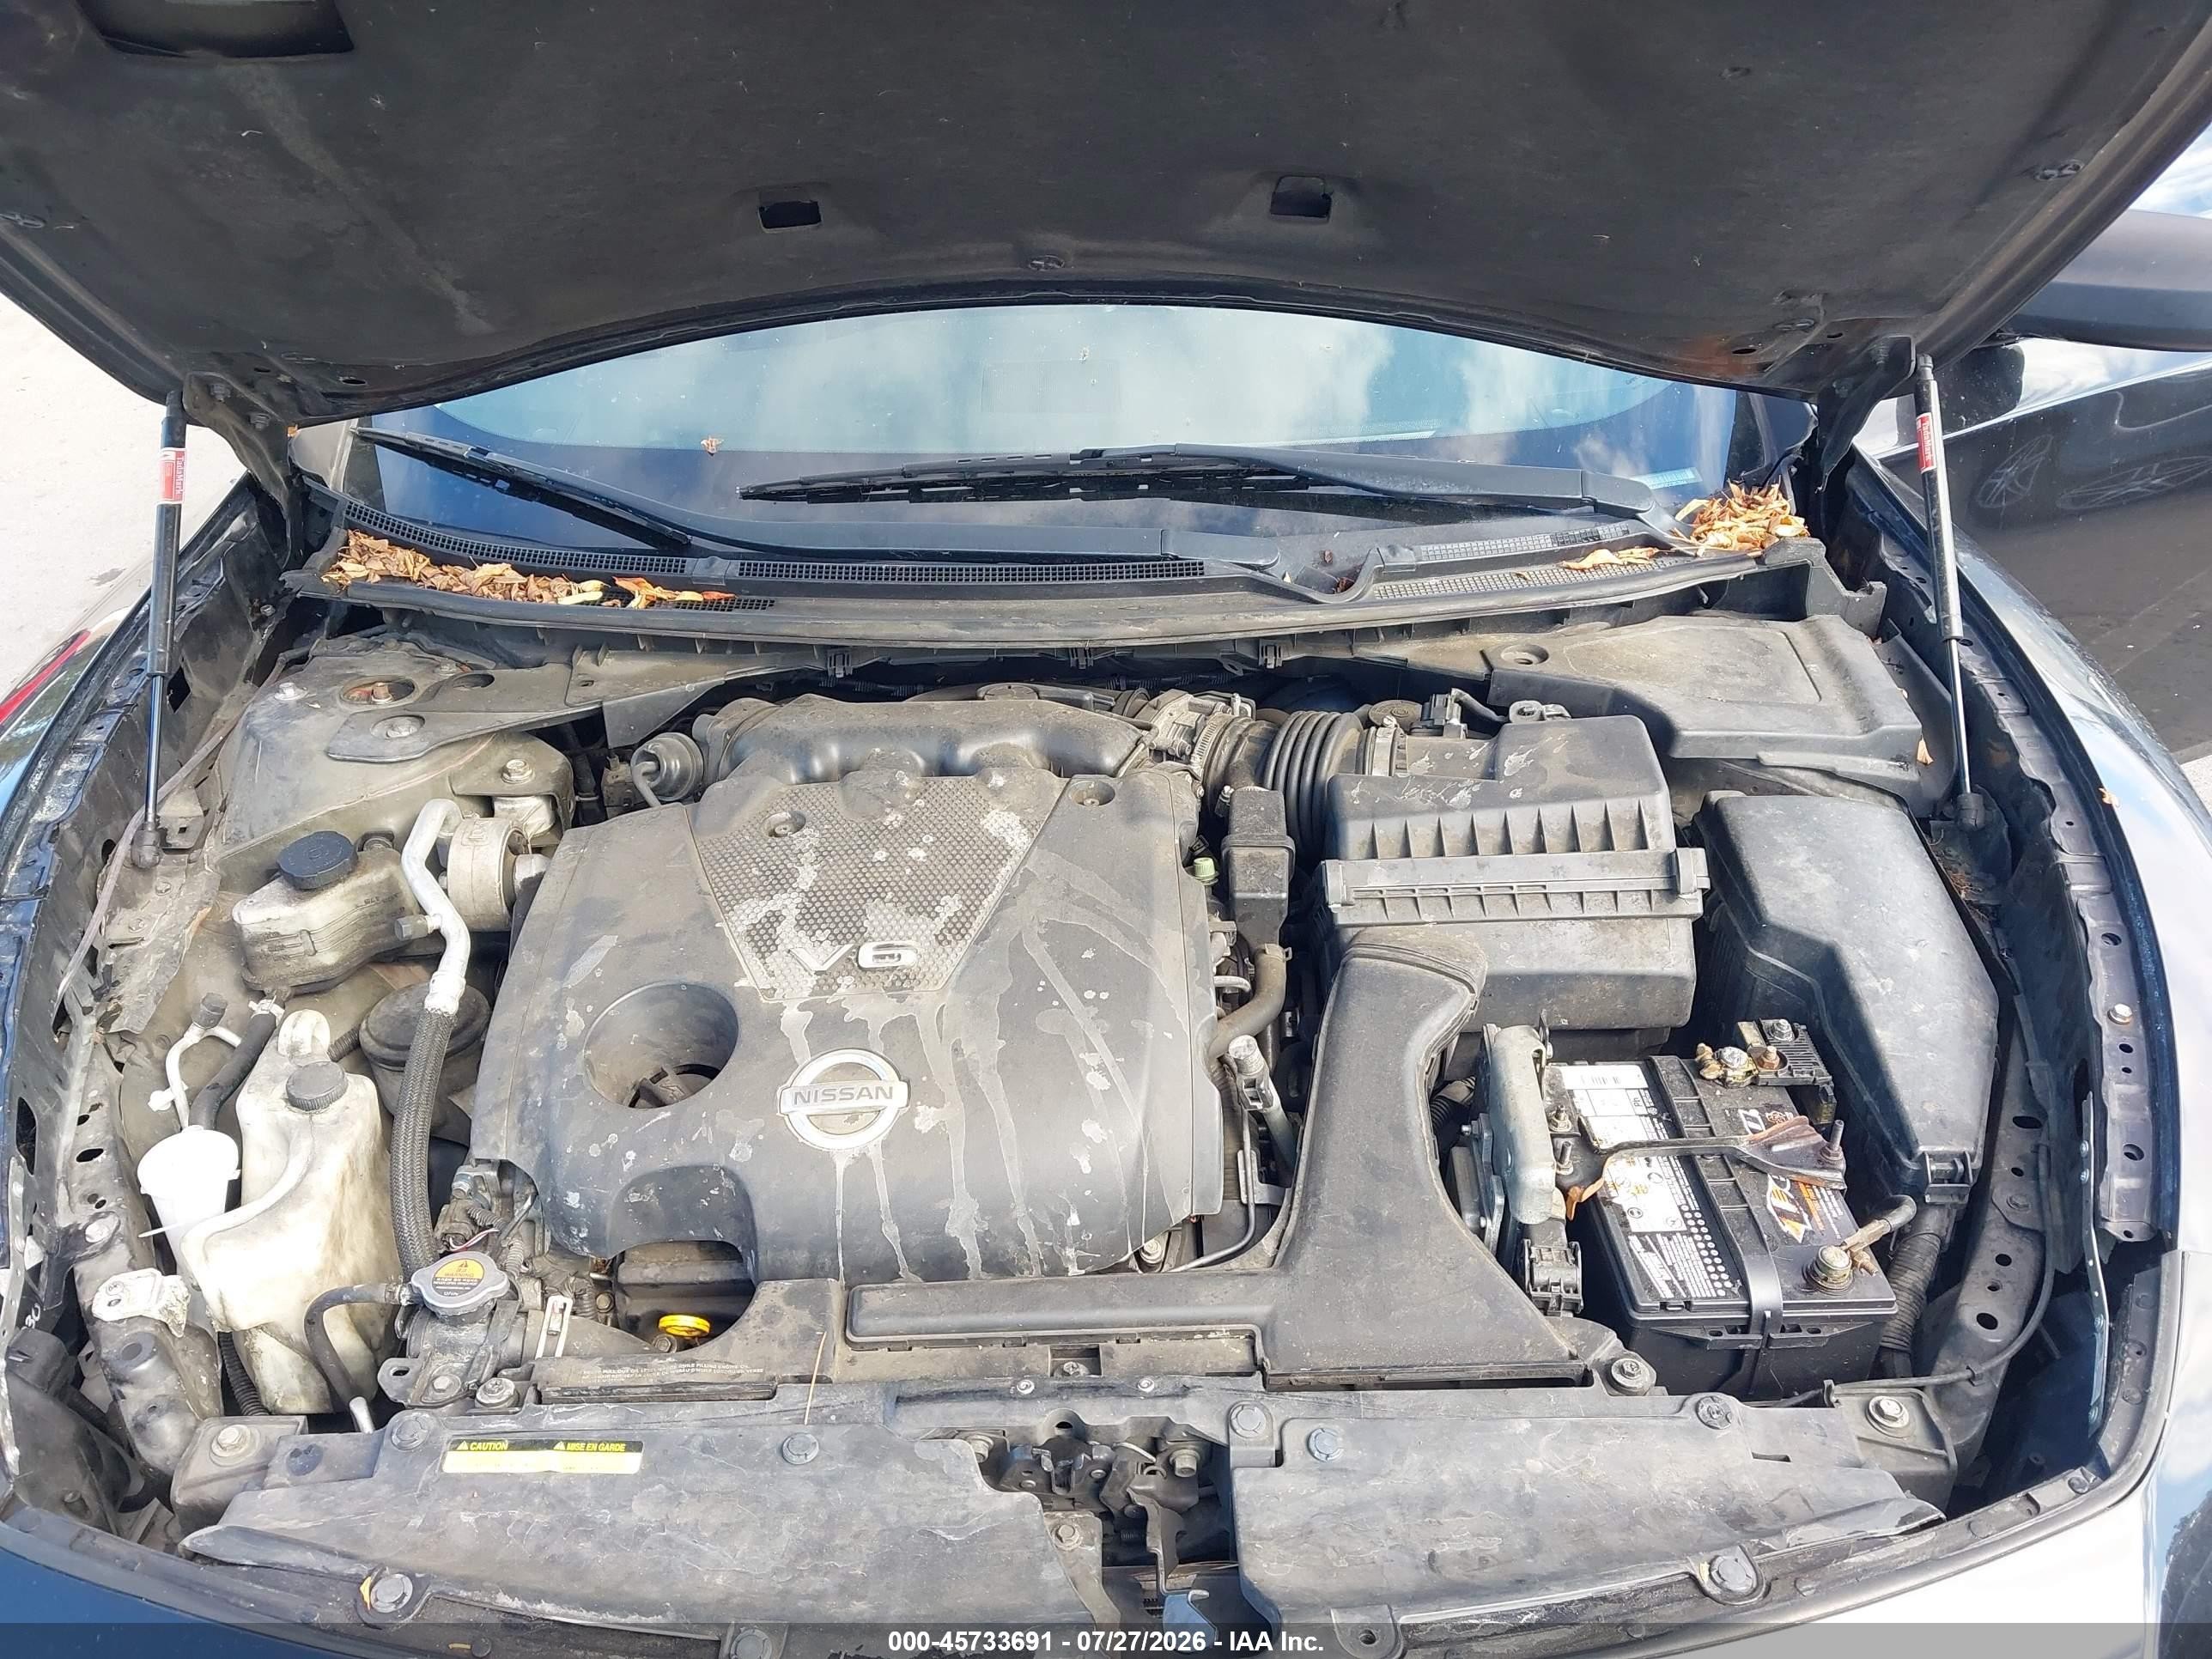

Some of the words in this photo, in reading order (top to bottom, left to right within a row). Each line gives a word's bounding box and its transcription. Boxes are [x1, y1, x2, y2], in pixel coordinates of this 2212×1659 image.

[787, 940, 920, 974] V6
[793, 1085, 894, 1105] NISSAN
[470, 1442, 508, 1450] CAUTION
[567, 1443, 586, 1451] MISE
[586, 1443, 597, 1451] EN
[598, 1443, 625, 1452] GARDE
